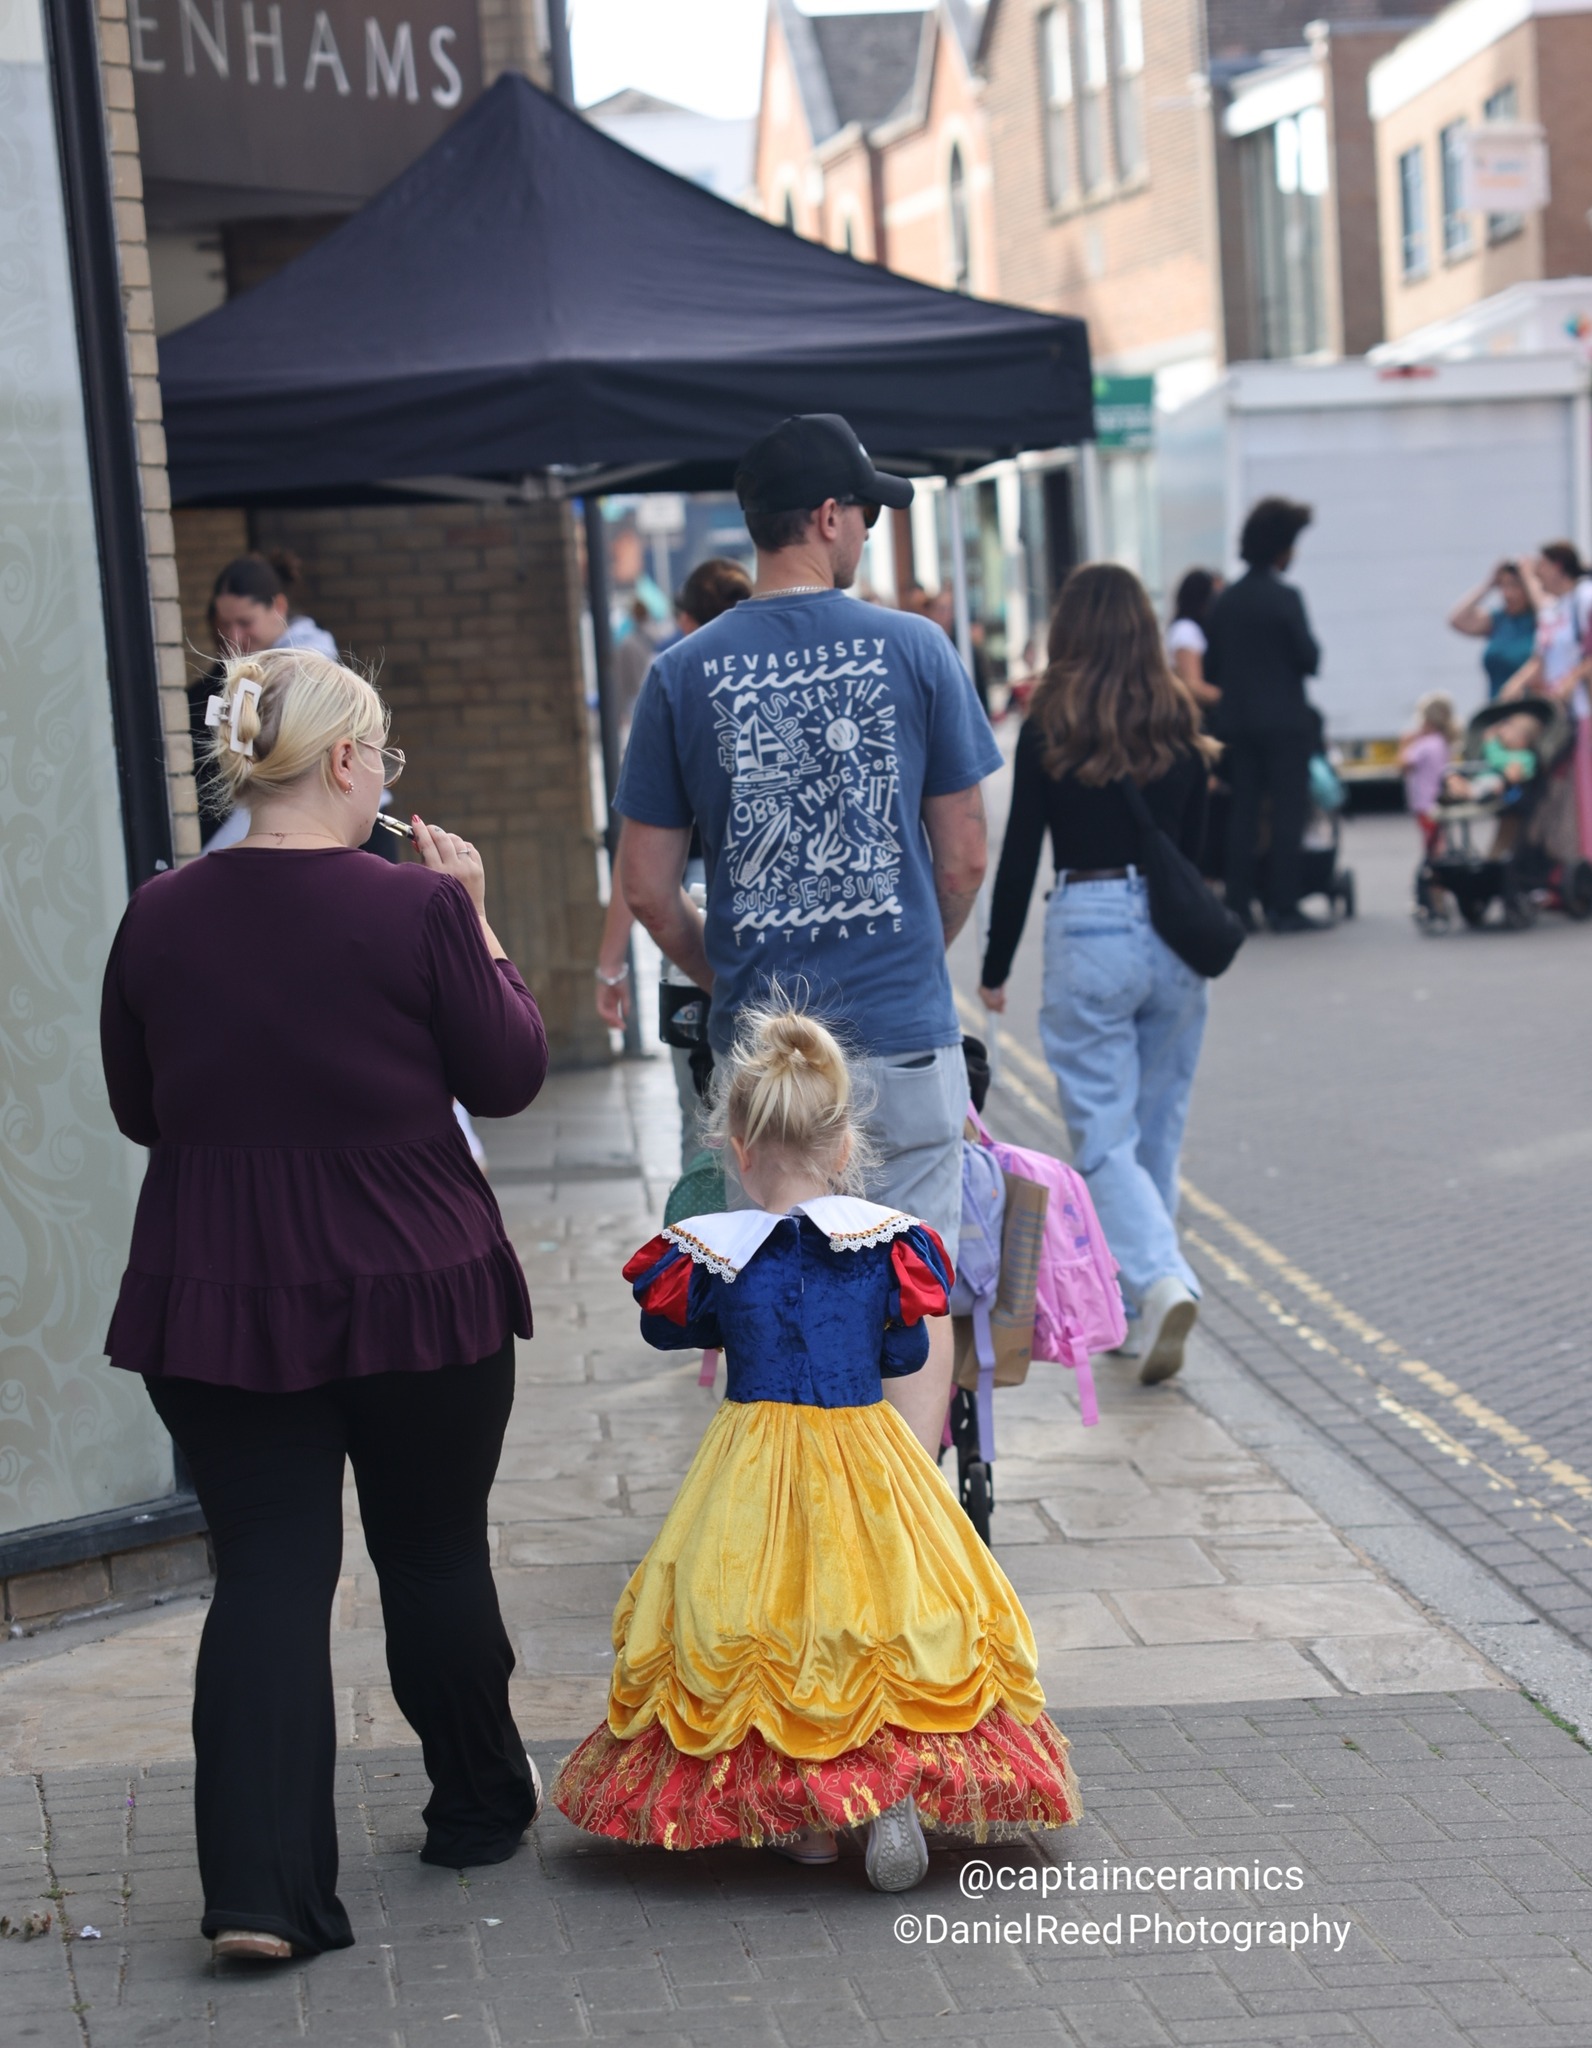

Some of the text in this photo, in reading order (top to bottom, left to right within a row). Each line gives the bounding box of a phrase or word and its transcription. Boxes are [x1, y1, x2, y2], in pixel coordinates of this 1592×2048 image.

[131, 0, 463, 110] ENHAMS
[703, 638, 886, 677] MEVAGISSEY
[789, 678, 896, 743] SEAS THE DAY
[797, 754, 900, 833] MADE FOR LIFE
[735, 918, 902, 946] FATFACE
